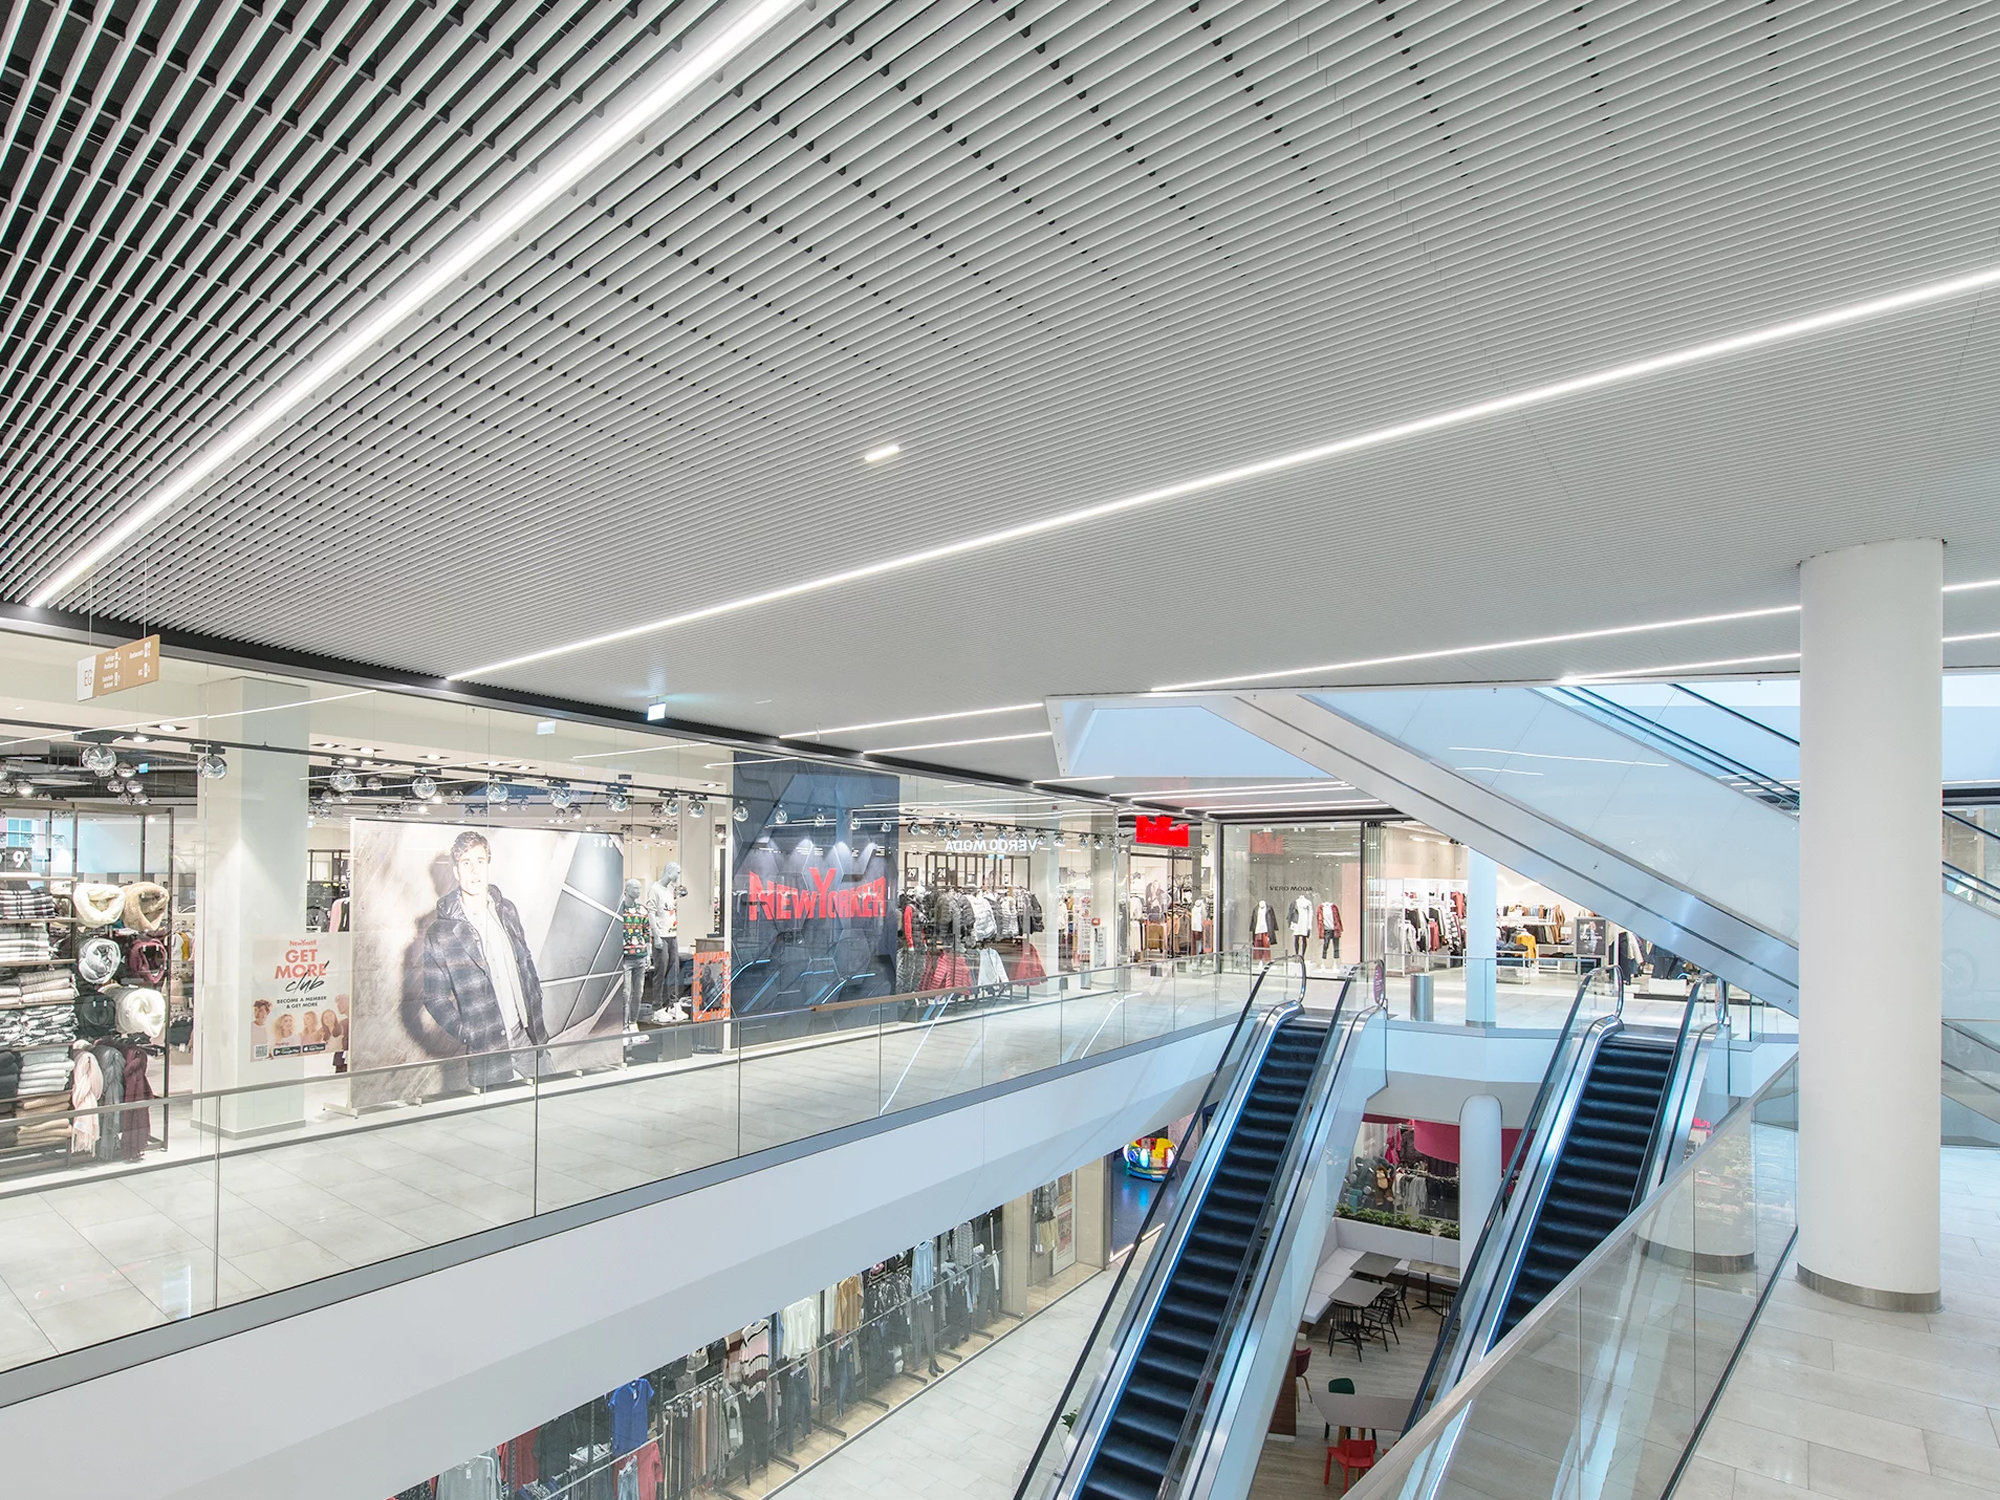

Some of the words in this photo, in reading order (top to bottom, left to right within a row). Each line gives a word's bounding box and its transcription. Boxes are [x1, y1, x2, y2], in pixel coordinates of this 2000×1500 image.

[84, 669, 92, 686] EG
[285, 949, 318, 963] GET
[274, 963, 327, 979] MORE
